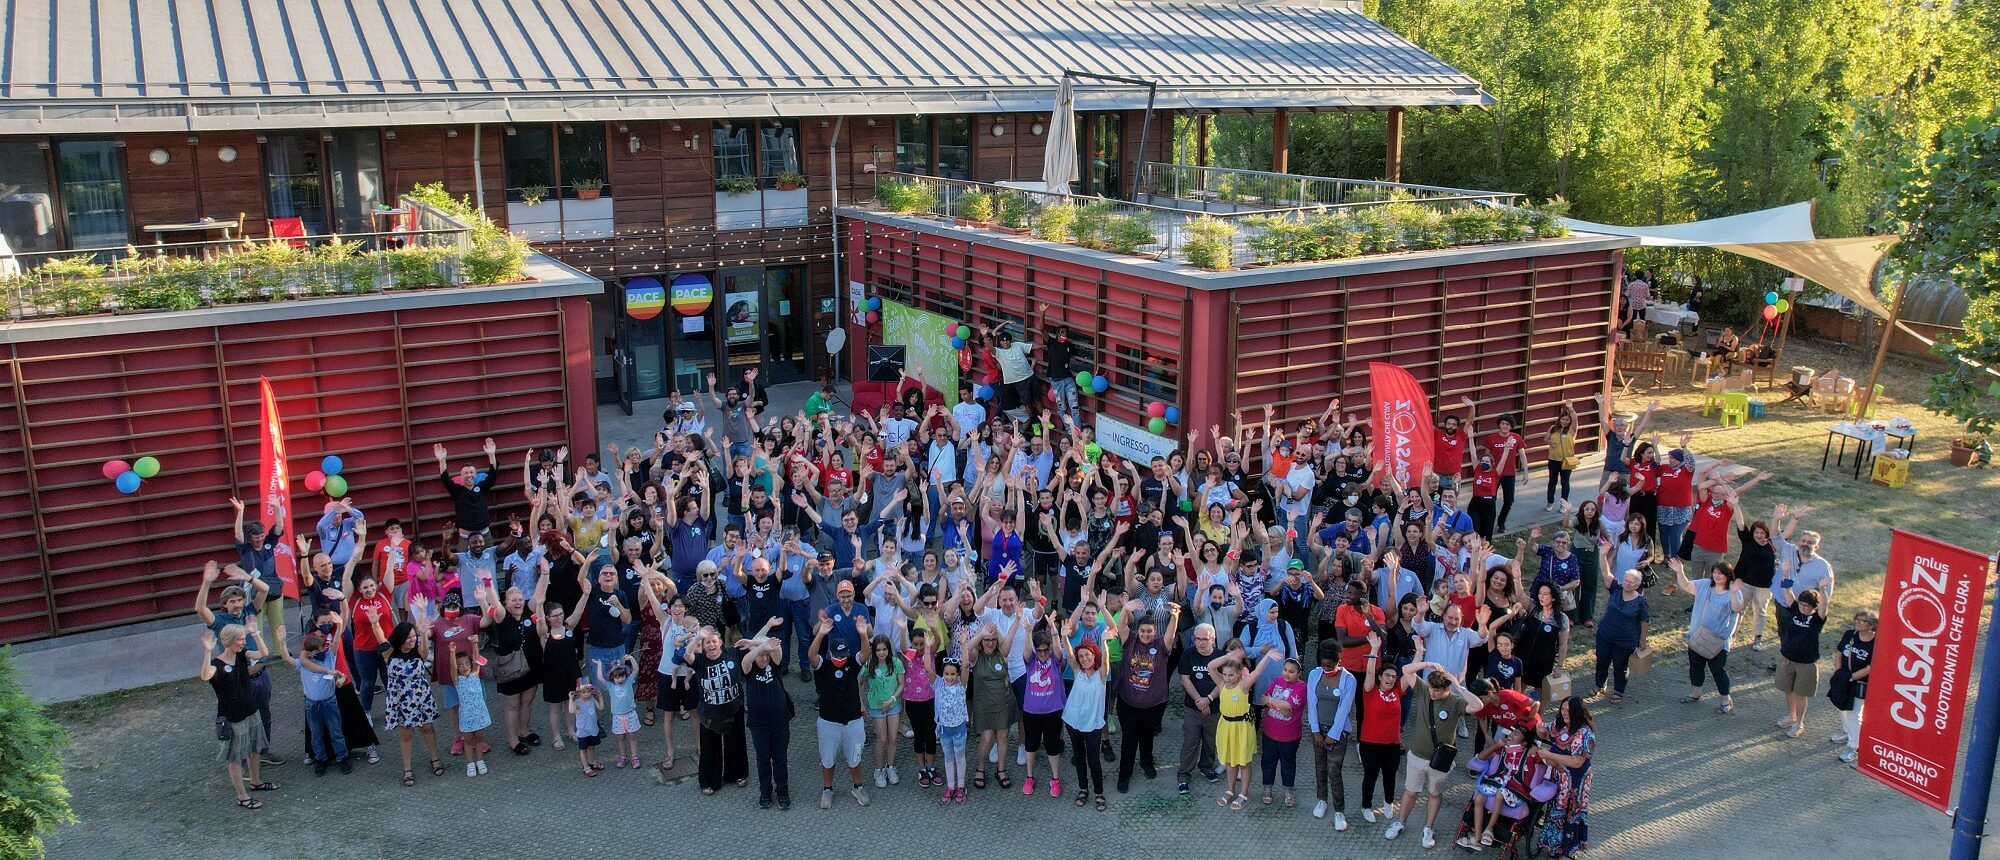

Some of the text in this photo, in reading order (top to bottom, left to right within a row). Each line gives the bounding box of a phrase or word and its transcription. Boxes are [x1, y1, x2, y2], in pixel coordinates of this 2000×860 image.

[628, 292, 660, 304] PACE
[675, 287, 707, 299] PACE
[1112, 432, 1150, 454] INGRESSO
[1914, 555, 1949, 573] onlus
[1935, 580, 1971, 730] QUOTIDIANITÀ CHE CURA
[1873, 744, 1938, 779] GIARDINO
[1879, 758, 1928, 787] RODARI
